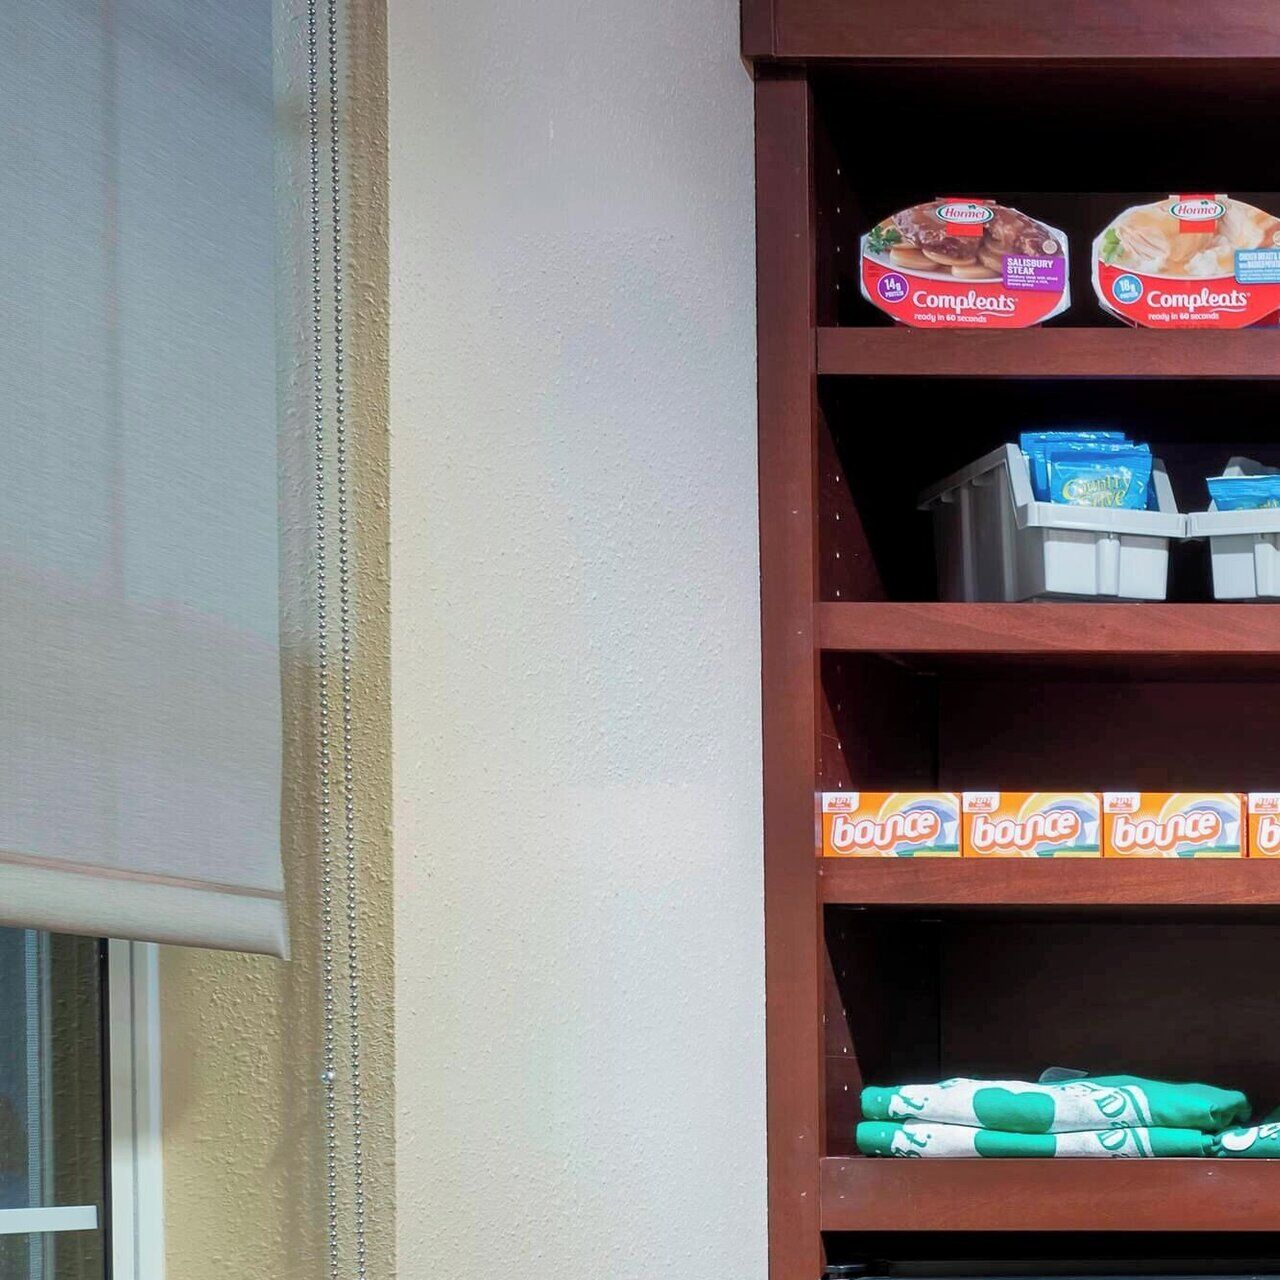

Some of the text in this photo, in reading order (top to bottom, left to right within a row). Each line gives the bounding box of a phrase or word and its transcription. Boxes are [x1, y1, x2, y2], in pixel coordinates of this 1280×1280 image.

[944, 206, 986, 219] Hormel
[1178, 204, 1219, 216] Hormel
[1007, 257, 1053, 268] SALISBURY
[1007, 267, 1035, 275] STEAK
[884, 279, 902, 292] 14g
[913, 291, 1015, 315] Compleats
[1147, 288, 1247, 312] Compleats
[914, 314, 936, 323] ready
[957, 315, 987, 323] seconds
[1149, 312, 1170, 321] ready
[832, 811, 938, 851] bounce
[972, 811, 1078, 850] bounce
[1112, 812, 1220, 850] bounce
